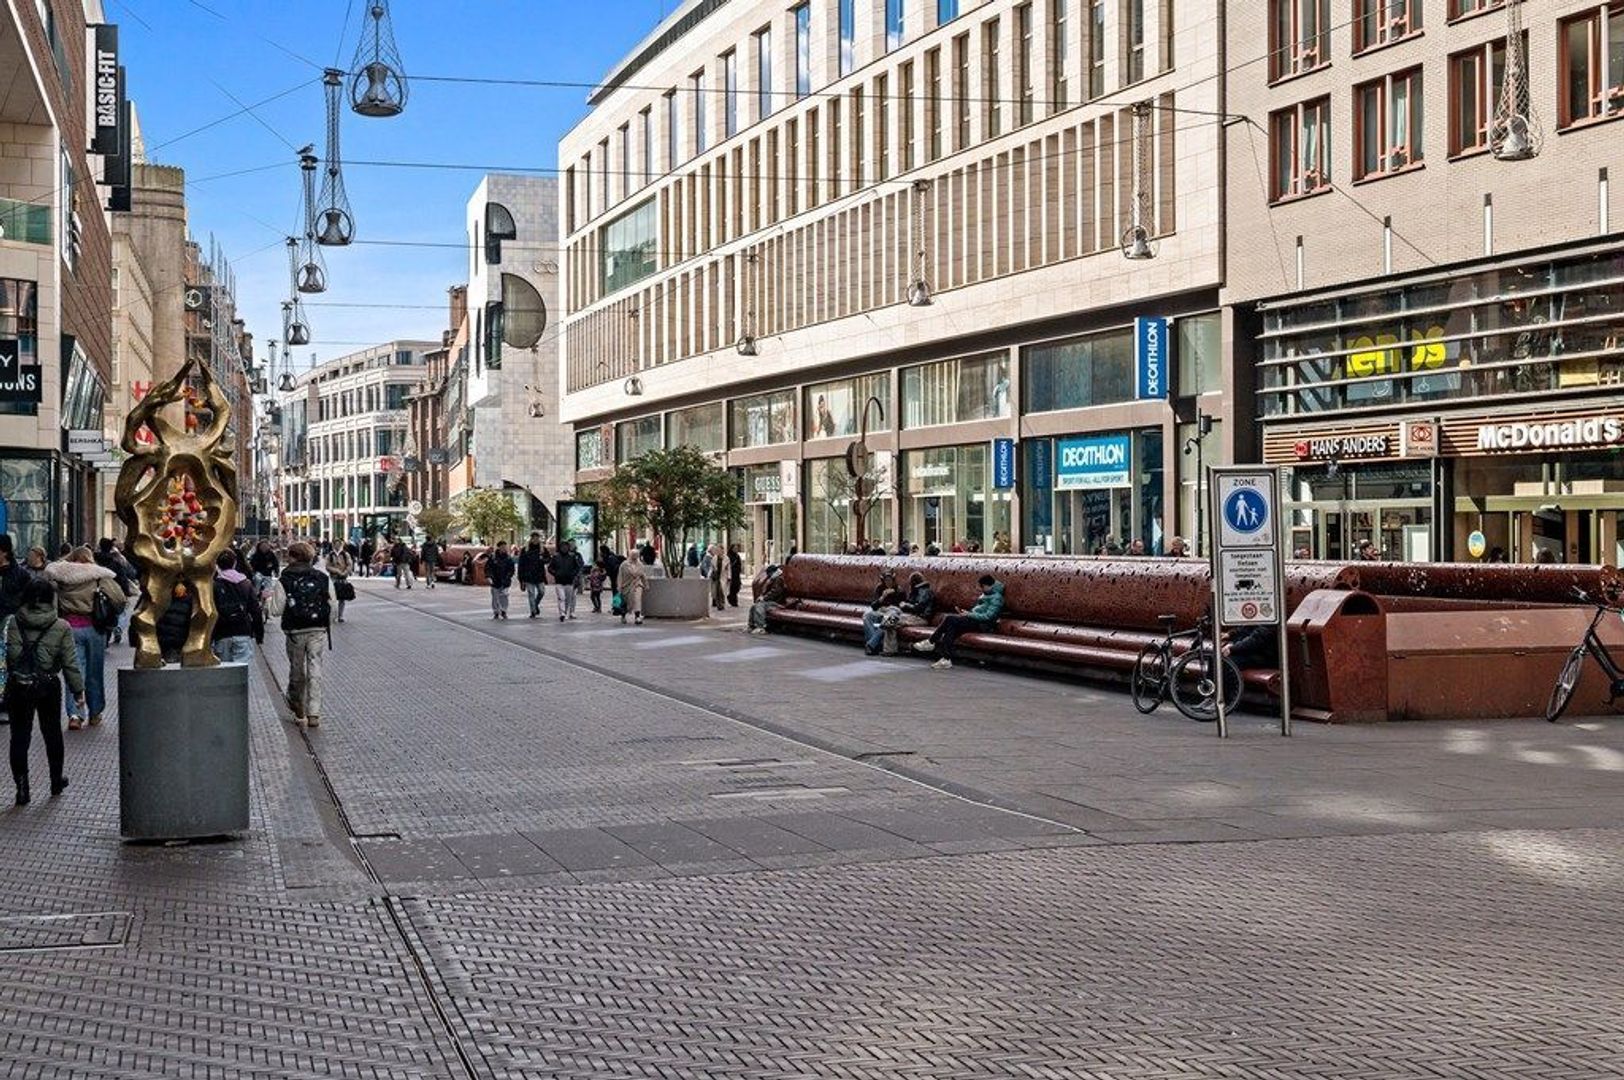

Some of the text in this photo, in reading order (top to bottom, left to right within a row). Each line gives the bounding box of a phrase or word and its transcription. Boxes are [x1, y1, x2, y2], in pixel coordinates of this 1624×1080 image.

[98, 50, 116, 126] BASIC-FIT
[1147, 322, 1158, 395] DECATHLON
[1310, 435, 1386, 456] HANS ANDERS
[1477, 417, 1621, 450] McDonald's
[1063, 443, 1124, 467] DECATHLON
[1233, 478, 1256, 486] ZONE
